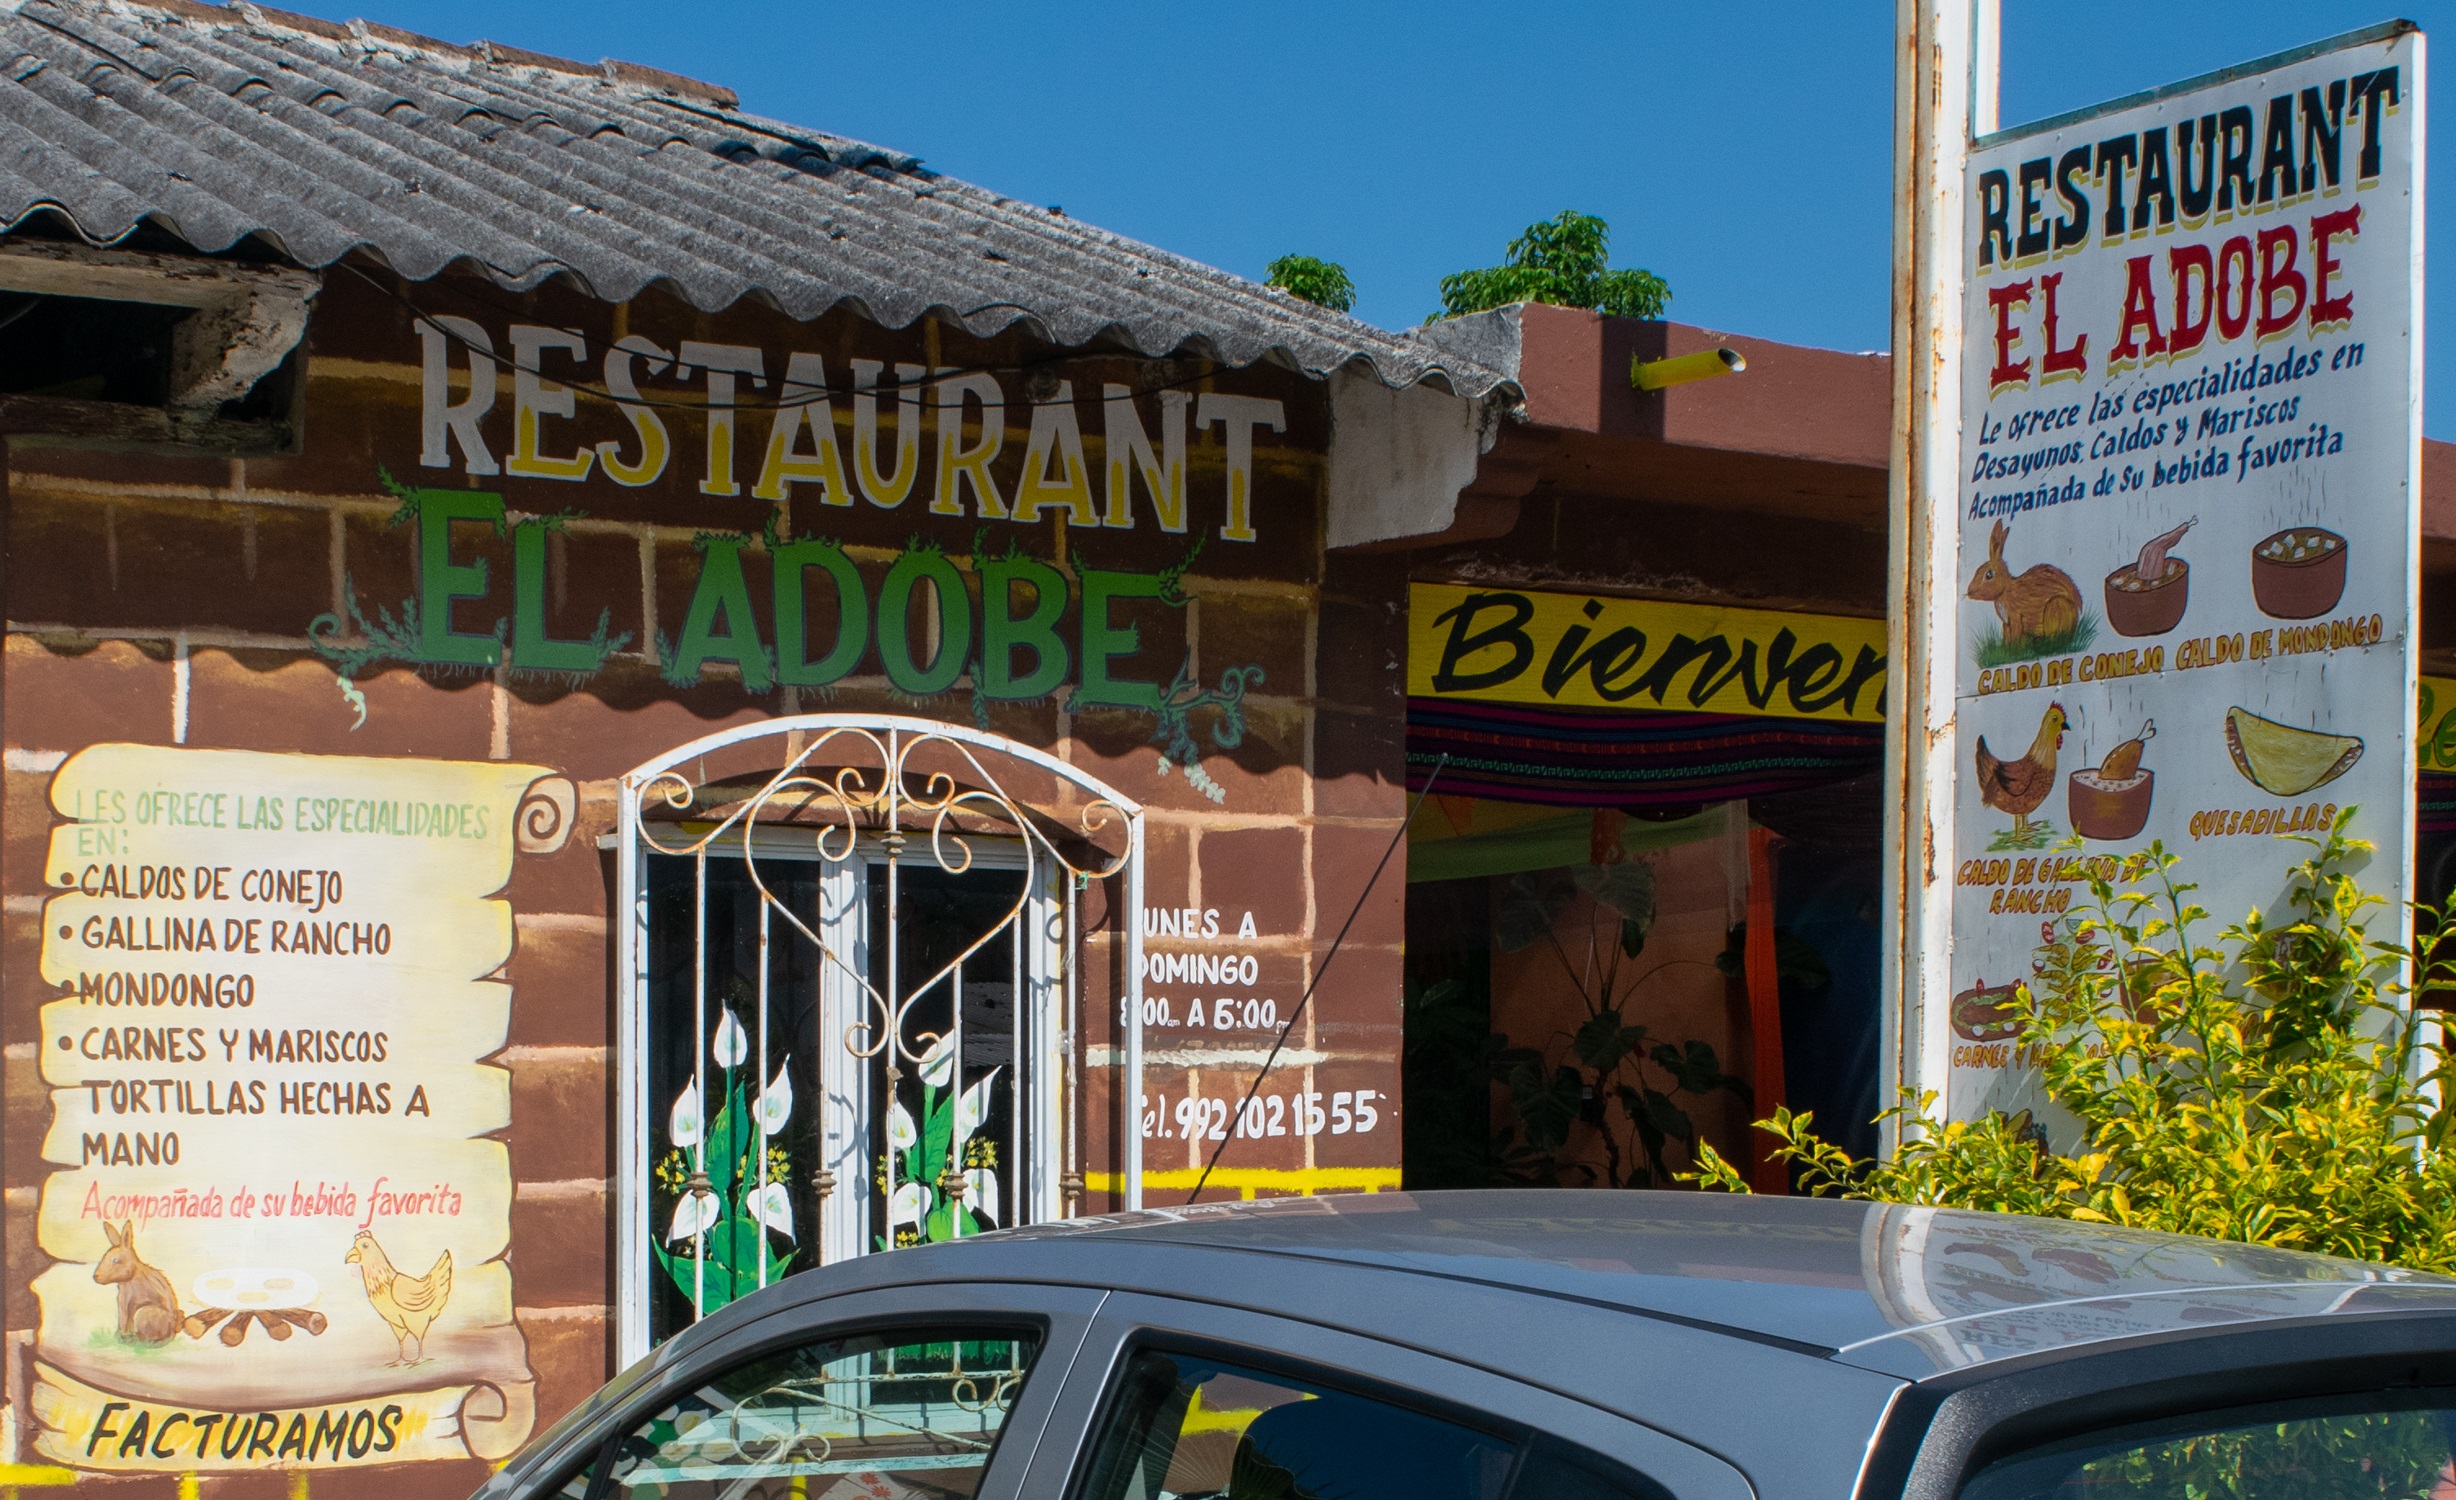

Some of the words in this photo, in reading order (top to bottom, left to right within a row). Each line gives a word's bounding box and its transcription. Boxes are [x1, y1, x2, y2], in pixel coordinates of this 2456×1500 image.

[1976, 65, 2401, 274] RESTAURANT
[1988, 272, 2089, 399] EL
[2106, 202, 2365, 377] ADOBE
[1978, 411, 2002, 446] Le
[2087, 392, 2124, 426] las
[2131, 353, 2324, 418] especialidades
[2330, 341, 2366, 371] en
[413, 314, 1286, 543] RESTAURANT
[2090, 415, 2169, 461] Caldos
[2196, 395, 2301, 442] Mariscos
[1967, 474, 2086, 522] Acompañada
[2092, 471, 2115, 498] de
[2151, 446, 2231, 489] bebida
[2236, 422, 2344, 484] favorita
[416, 487, 604, 678] EL
[660, 530, 1176, 714] ADOBE
[1431, 590, 1887, 718] Bienven
[1978, 663, 2043, 695] CALDO
[2047, 658, 2074, 688] DE
[2078, 645, 2164, 683] CONEJO
[2176, 633, 2245, 672] CALDO
[2249, 628, 2273, 660] DE
[76, 789, 127, 825] LES
[136, 791, 229, 829] OFRECE
[237, 795, 285, 831] LAS
[294, 797, 491, 840] ESPECIALIDADES
[2189, 802, 2338, 842] QUESADILLAS
[80, 863, 187, 901] CALDOS
[194, 866, 232, 901] DE
[241, 868, 343, 914] CONEJO
[1956, 858, 2011, 887] CALDO
[2012, 856, 2038, 886] DE
[1142, 907, 1220, 940] UNES
[1238, 911, 1258, 940] A
[1989, 887, 2072, 915] RANCHO
[81, 915, 218, 952] GALLINA
[224, 918, 263, 954] DE
[271, 919, 392, 957] RANCHO
[79, 971, 256, 1010] MONDONGO
[1186, 998, 1206, 1028] A
[79, 1026, 206, 1062] CARNES
[219, 1029, 240, 1062] Y
[248, 1028, 388, 1064] MARISCOS
[82, 1079, 265, 1117] TORTILLAS
[280, 1081, 392, 1117] HECHAS
[404, 1085, 431, 1118] A
[81, 1131, 180, 1167] MANO
[80, 1180, 224, 1231] Acompañada
[228, 1185, 256, 1219] de
[260, 1193, 286, 1218] su
[290, 1181, 358, 1218] bebida
[358, 1177, 462, 1229] favorita
[85, 1402, 404, 1461] FACTURAMOS
